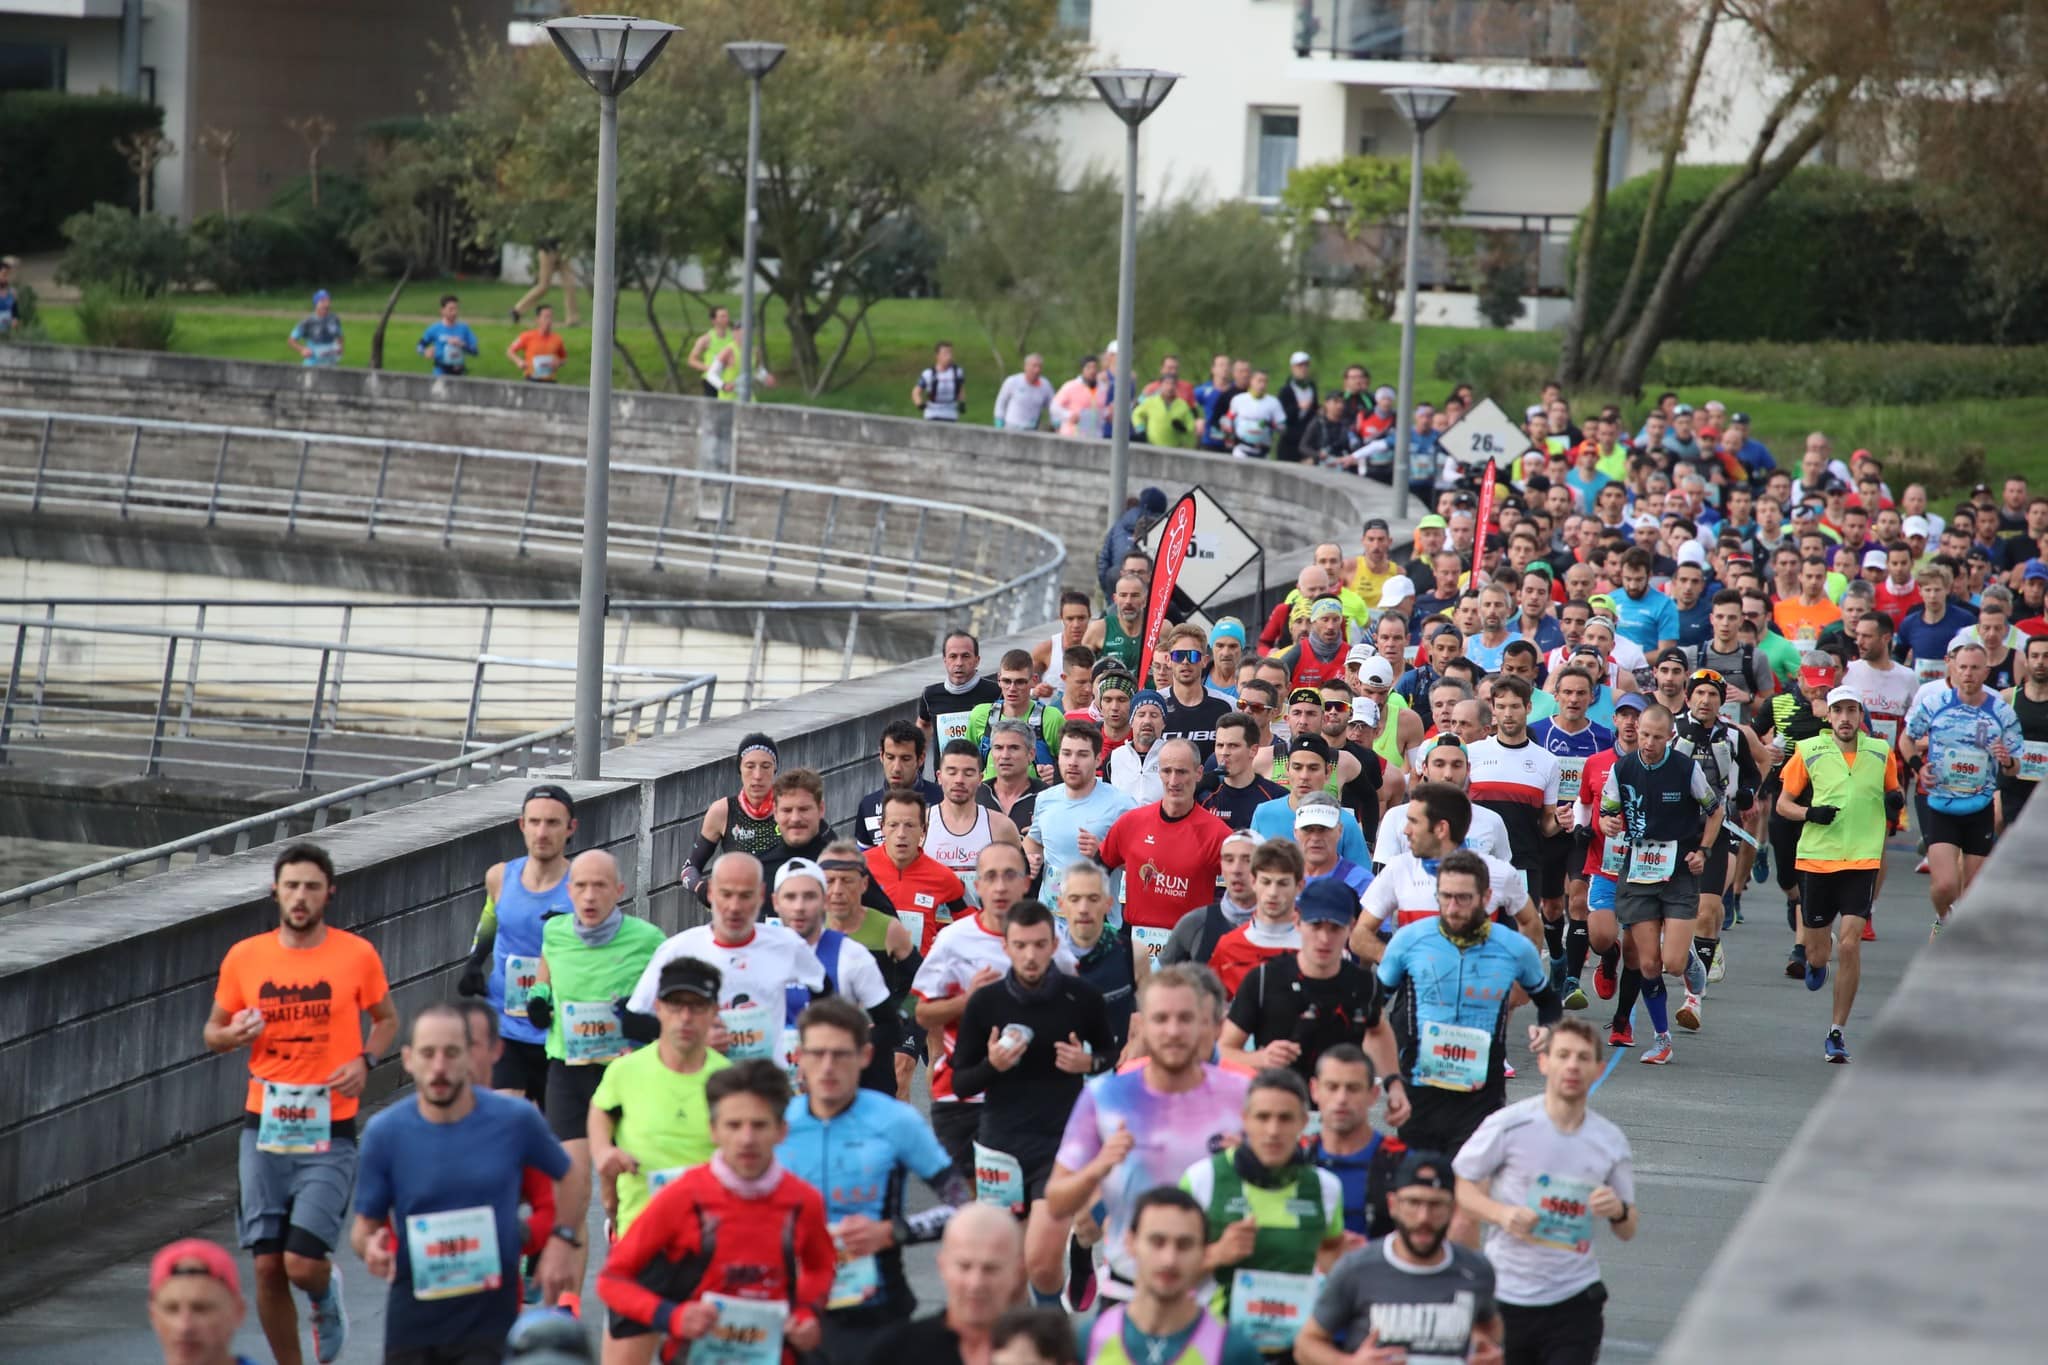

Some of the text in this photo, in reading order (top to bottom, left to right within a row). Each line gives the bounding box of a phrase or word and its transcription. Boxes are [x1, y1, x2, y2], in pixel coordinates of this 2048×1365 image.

[1471, 433, 1493, 451] 26
[1560, 769, 1579, 782] 366
[1643, 851, 1661, 865] 708
[1155, 873, 1189, 891] RUN
[1164, 888, 1188, 898] NIORT
[581, 1021, 607, 1037] 278
[730, 1029, 755, 1048] 315
[1443, 1042, 1467, 1062] 501
[279, 1104, 307, 1124] 664
